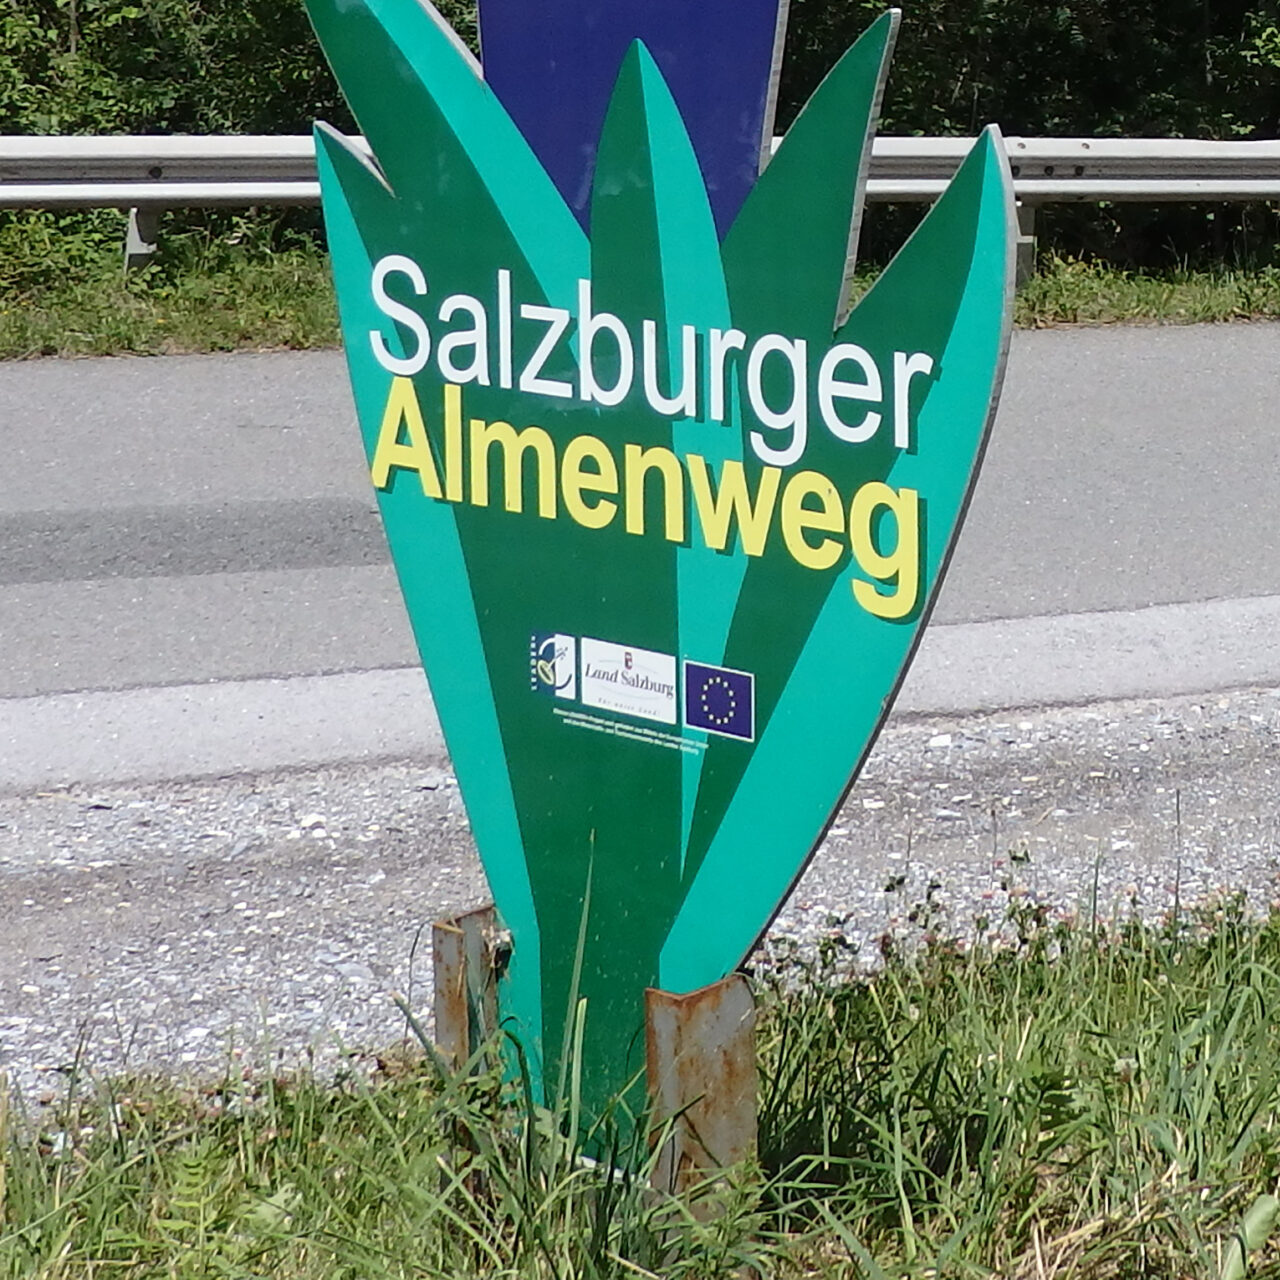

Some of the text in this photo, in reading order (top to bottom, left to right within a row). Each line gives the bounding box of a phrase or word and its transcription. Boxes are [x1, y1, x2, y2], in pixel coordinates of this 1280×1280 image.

[369, 254, 934, 467] Salzburger
[371, 375, 919, 619] Almenweg
[585, 663, 674, 700] Land Salzburg
